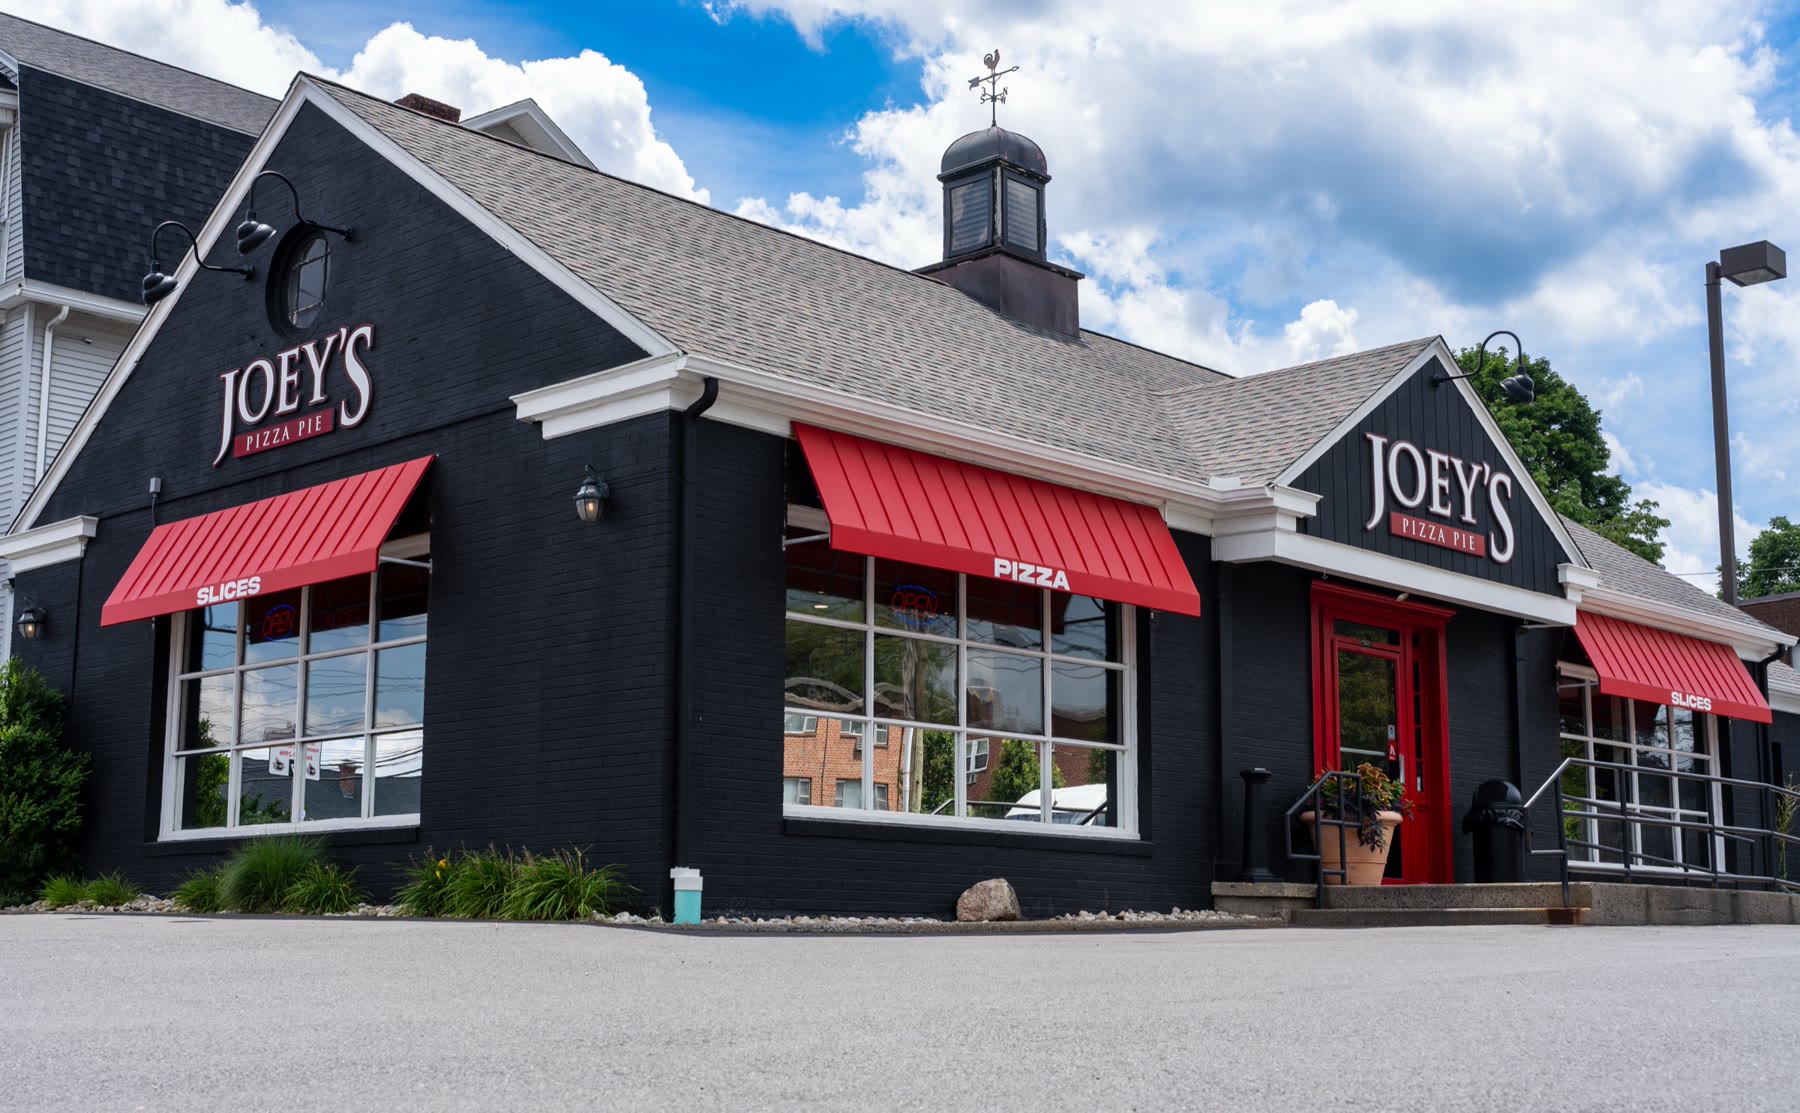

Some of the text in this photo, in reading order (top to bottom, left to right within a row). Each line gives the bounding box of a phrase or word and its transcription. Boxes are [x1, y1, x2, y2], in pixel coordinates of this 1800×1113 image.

[212, 324, 374, 467] JOEY'S
[246, 415, 322, 451] PIZZA PIE
[1365, 432, 1515, 563] JOEY'S
[1402, 517, 1475, 551] PIZZA PIE
[196, 576, 262, 606] SLICES
[994, 557, 1071, 591] PIZZA
[891, 591, 939, 618] OPEN
[262, 609, 297, 637] OPEN
[1671, 691, 1712, 711] SLICES
